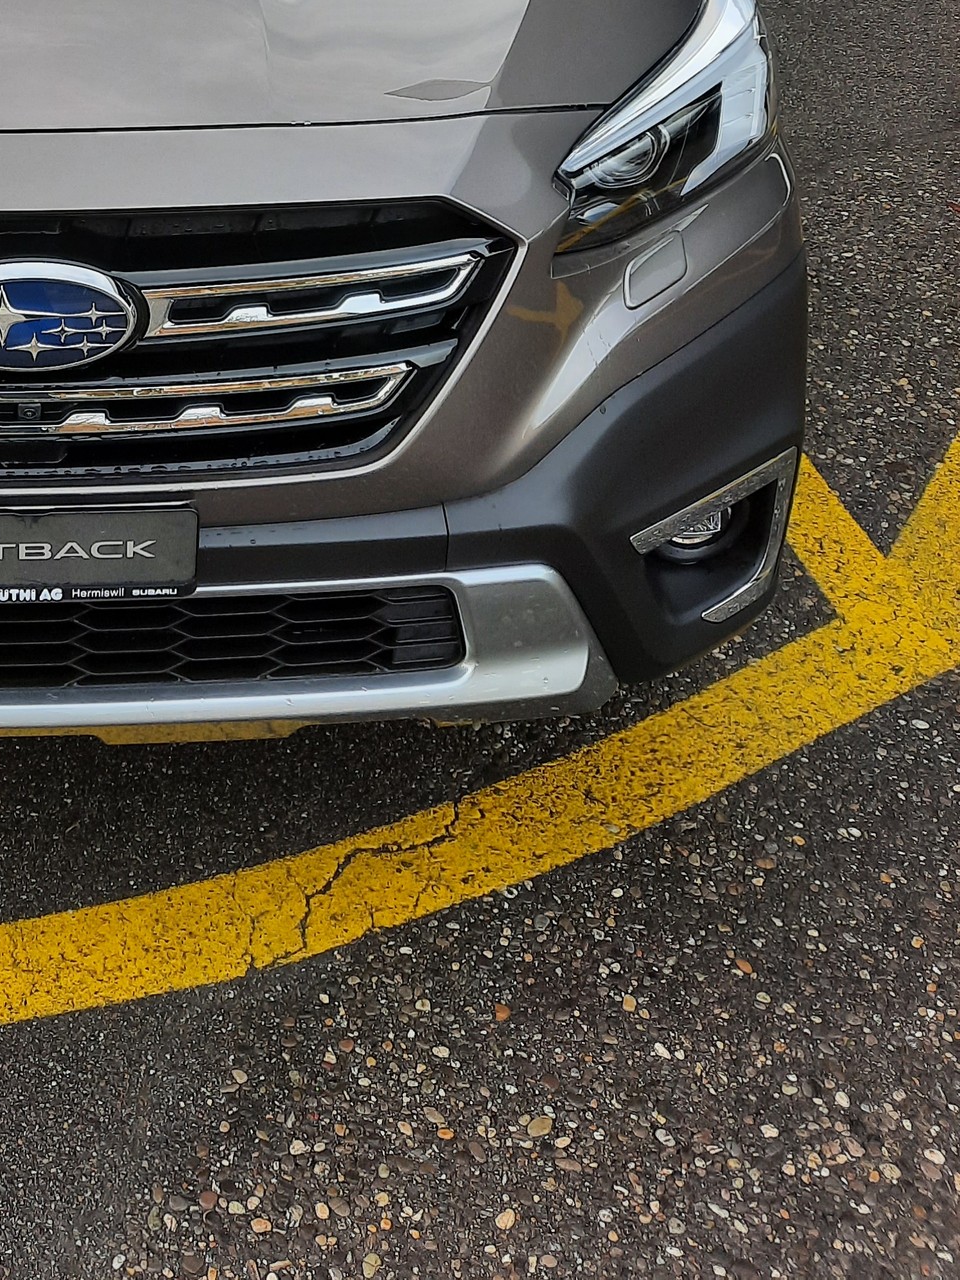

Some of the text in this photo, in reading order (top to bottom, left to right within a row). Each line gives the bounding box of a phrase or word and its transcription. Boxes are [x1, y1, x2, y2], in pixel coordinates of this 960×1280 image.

[39, 587, 63, 601] AG
[71, 587, 124, 598] Hermiswil
[131, 588, 178, 596] SUBARU
